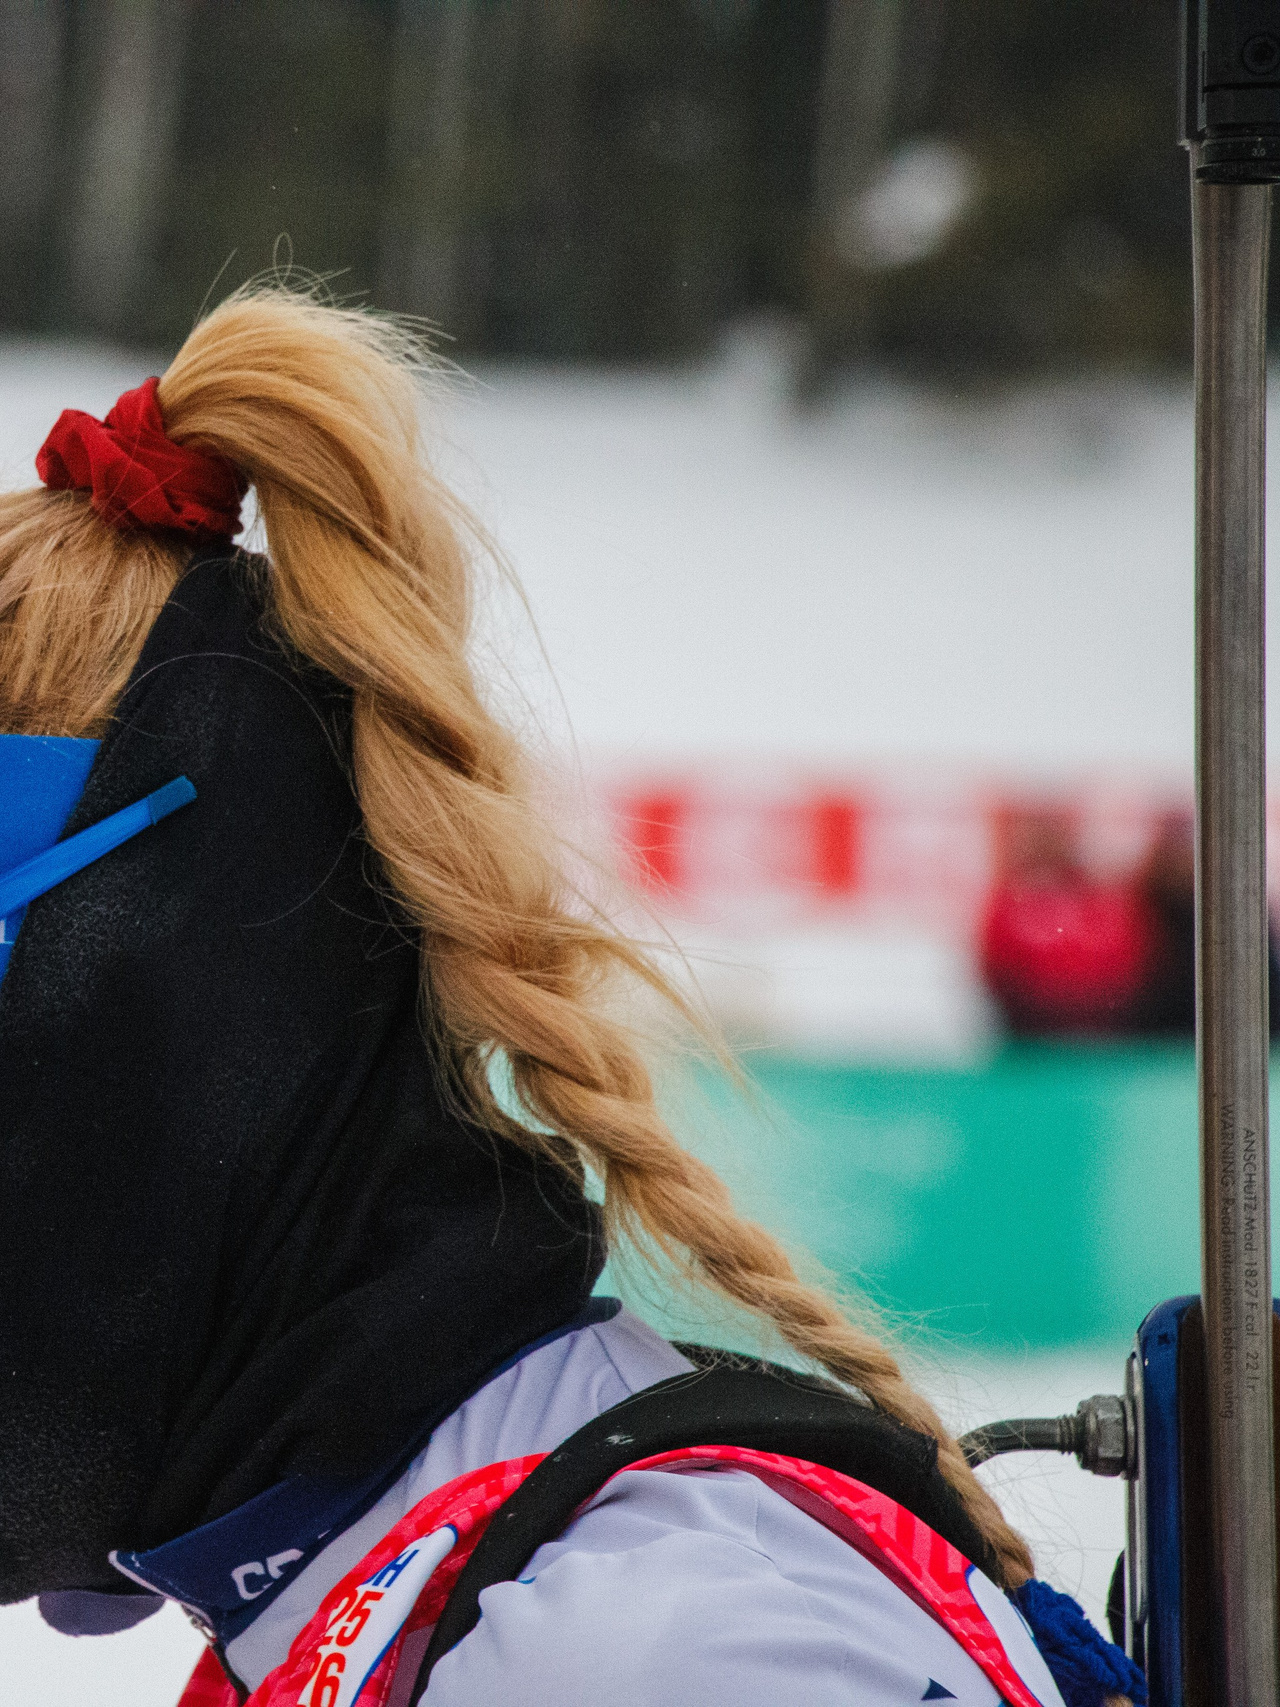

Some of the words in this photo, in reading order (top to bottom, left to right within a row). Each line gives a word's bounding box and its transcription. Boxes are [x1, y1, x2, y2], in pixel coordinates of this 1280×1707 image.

[1221, 1197, 1237, 1236] Read
[1222, 1240, 1237, 1323] instructions
[1245, 1261, 1259, 1299] 1827
[1245, 1301, 1259, 1311] F
[1223, 1326, 1238, 1376] before
[1219, 1380, 1239, 1419] using
